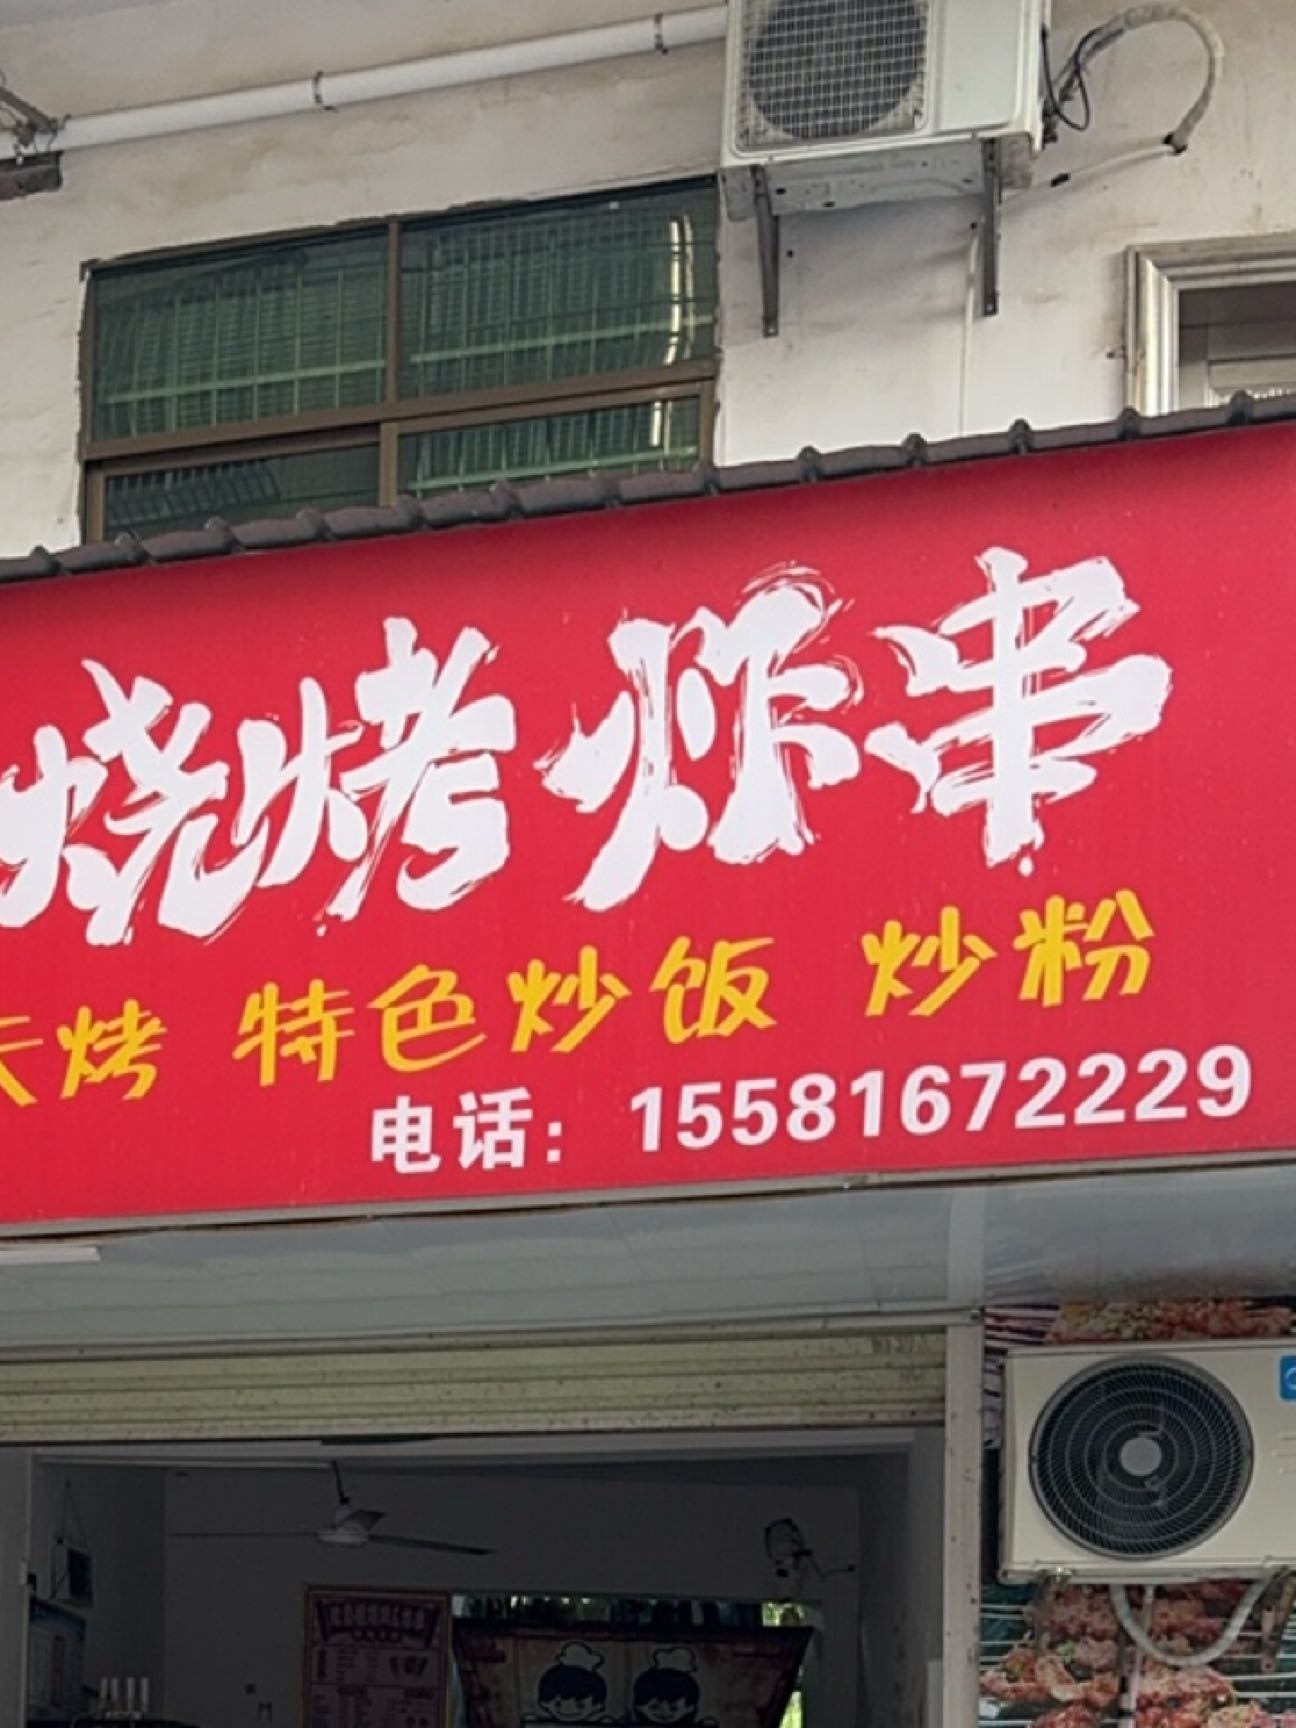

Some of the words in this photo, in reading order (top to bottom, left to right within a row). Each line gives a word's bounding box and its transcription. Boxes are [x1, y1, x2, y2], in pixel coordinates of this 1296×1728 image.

[233, 934, 776, 1088] 特色炒饭
[860, 890, 1154, 1019] 炒粉
[630, 1044, 1254, 1153] 15581672229
